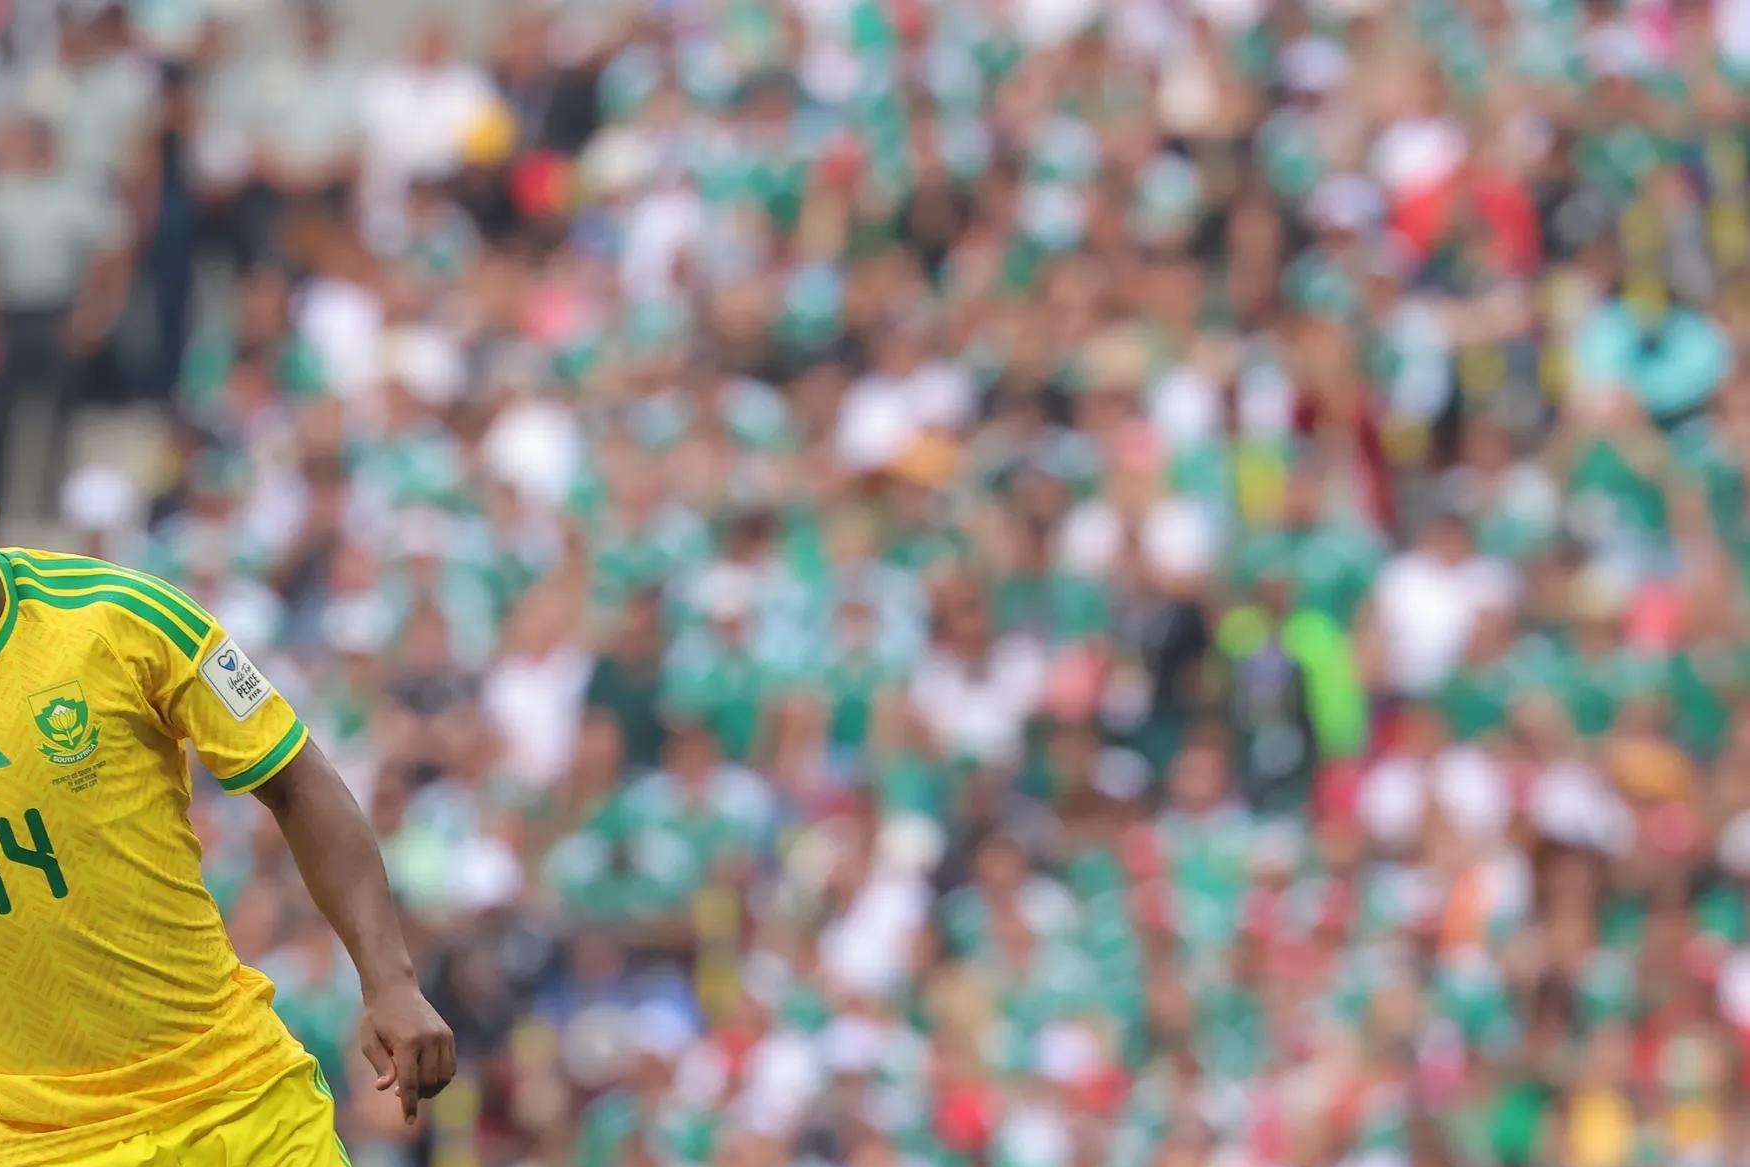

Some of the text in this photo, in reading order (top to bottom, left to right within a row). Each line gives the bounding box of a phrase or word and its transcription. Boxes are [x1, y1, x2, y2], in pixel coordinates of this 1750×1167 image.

[235, 672, 261, 699] PEACE
[248, 688, 262, 701] FIFA
[53, 743, 97, 763] SOUTH AFRICA
